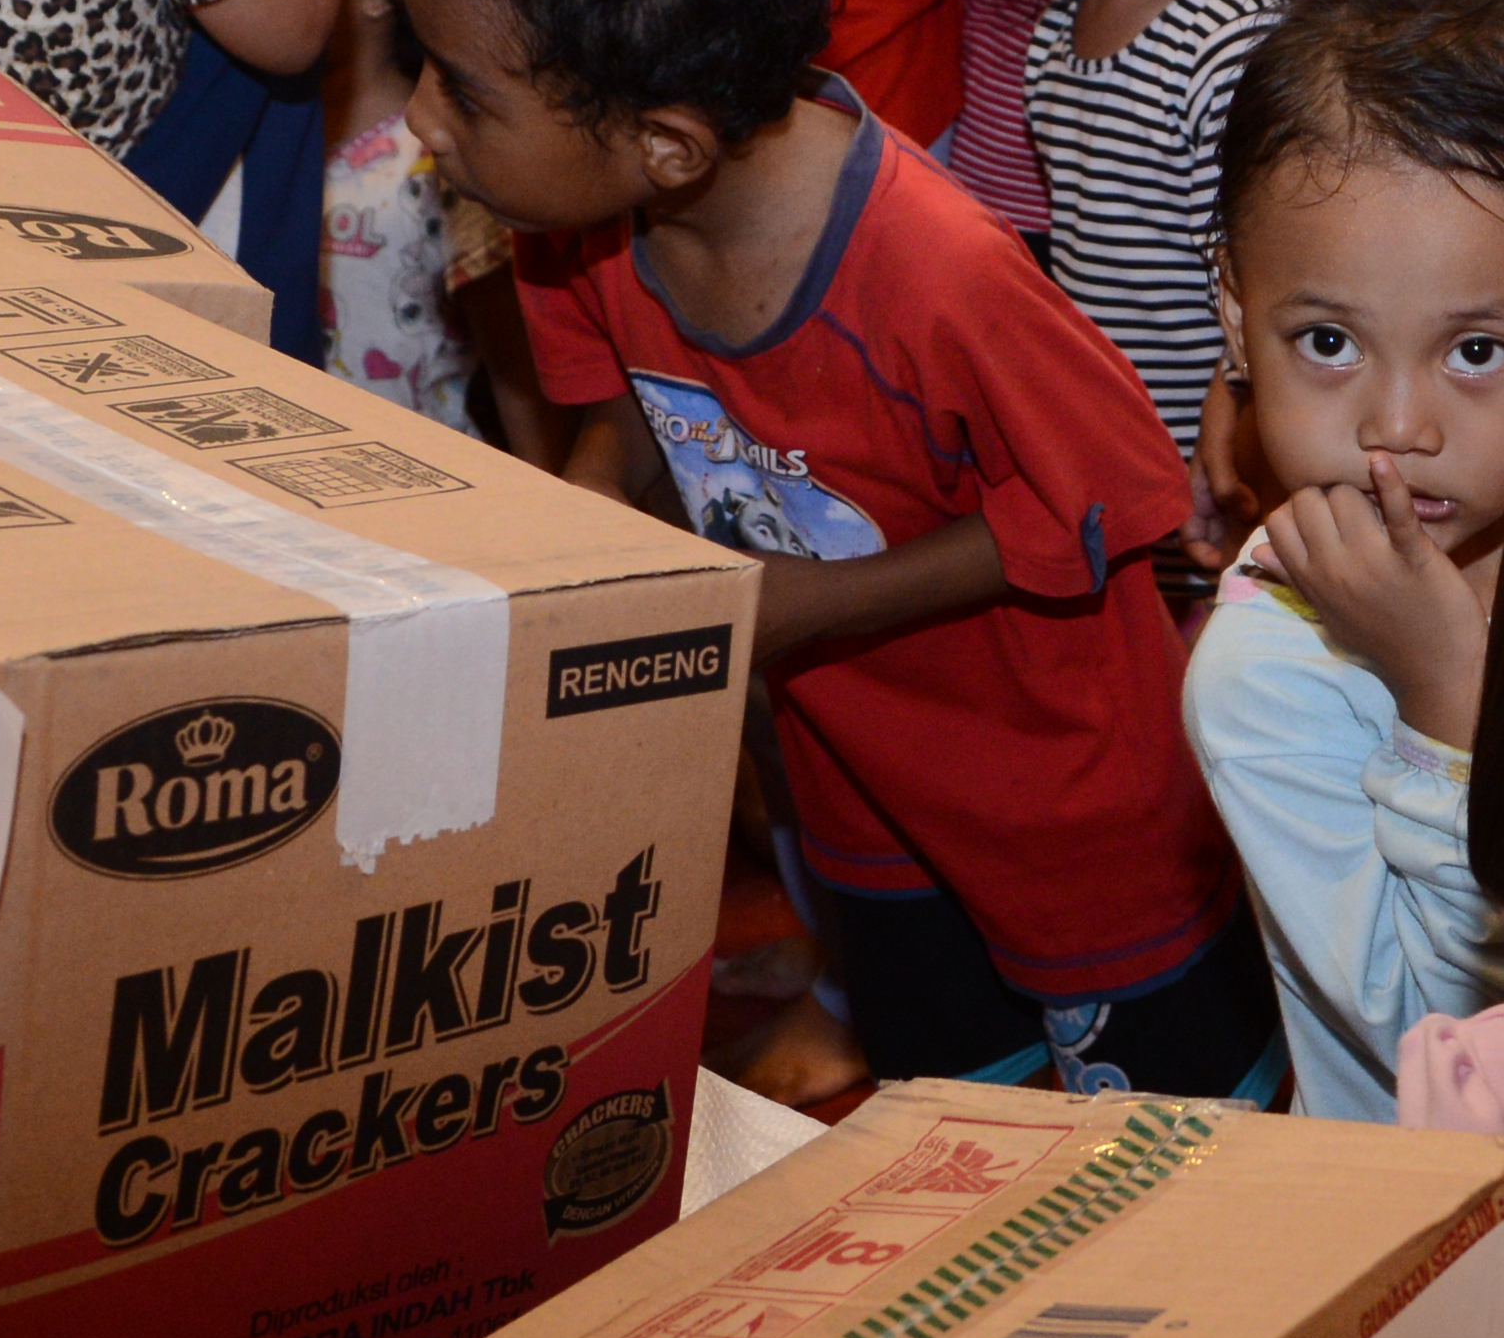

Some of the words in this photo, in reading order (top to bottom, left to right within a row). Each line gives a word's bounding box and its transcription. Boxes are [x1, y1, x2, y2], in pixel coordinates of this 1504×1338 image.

[557, 645, 722, 700] RENCENG
[93, 746, 309, 845] Roma
[98, 844, 663, 1136] Malkist
[95, 1043, 571, 1248] Crackers
[552, 1094, 656, 1159] CRACKERS
[561, 1201, 612, 1221] DENGAN
[396, 1257, 450, 1295] oleh
[482, 1268, 537, 1306] Tbk
